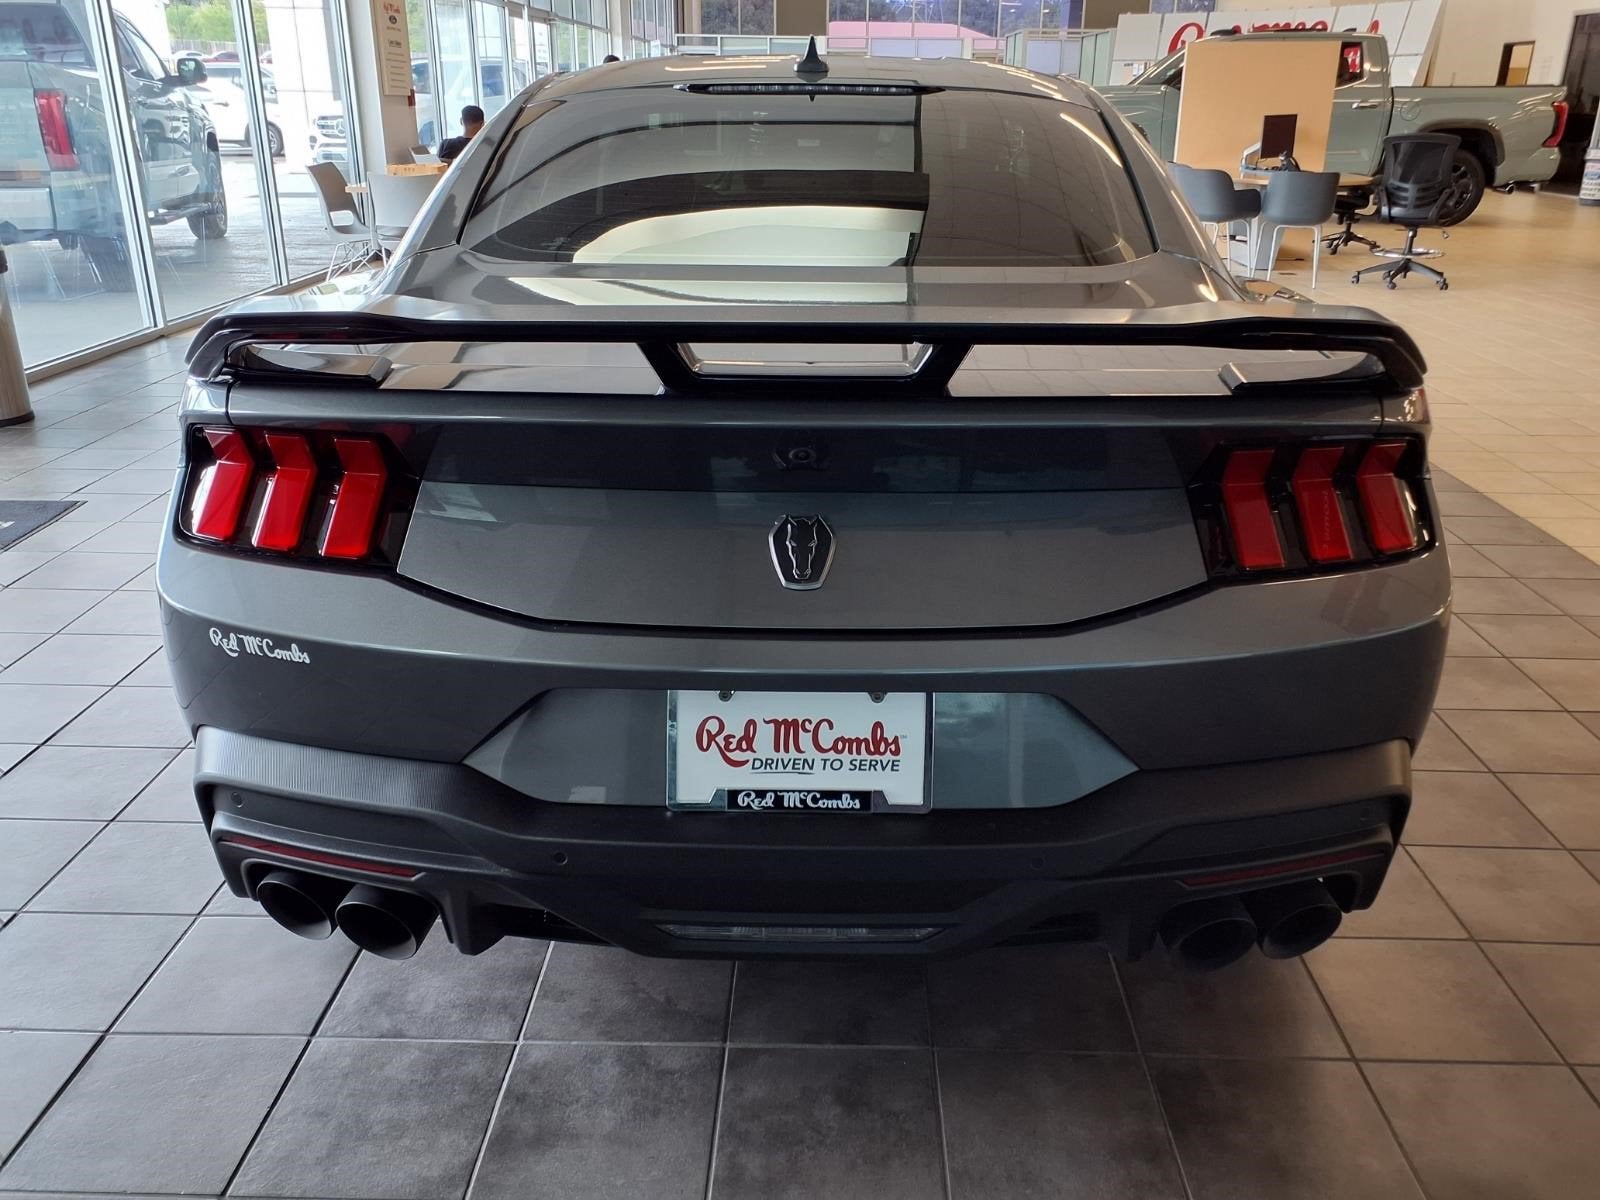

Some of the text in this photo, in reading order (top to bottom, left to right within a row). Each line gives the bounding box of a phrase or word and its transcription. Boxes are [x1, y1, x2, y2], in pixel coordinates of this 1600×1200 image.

[209, 627, 311, 664] Red McCombs
[695, 715, 901, 768] Red McCombs
[751, 758, 900, 772] DRIVEN TO SERVE
[737, 790, 860, 810] Red McCombs
